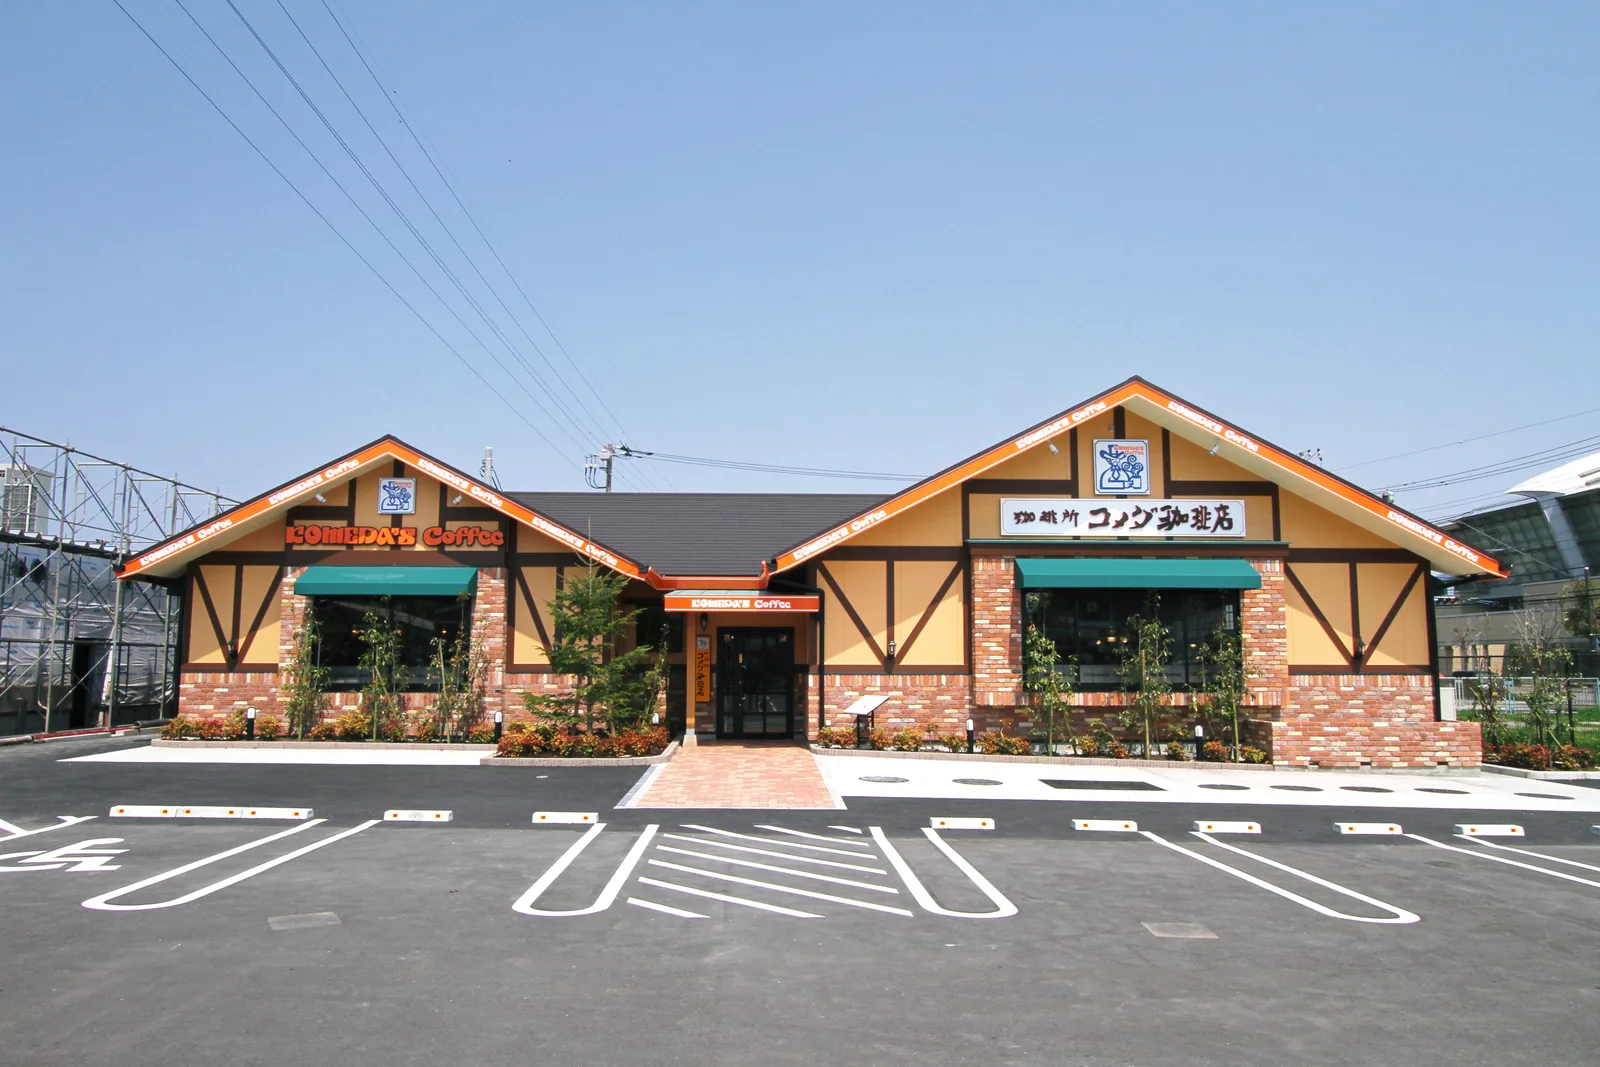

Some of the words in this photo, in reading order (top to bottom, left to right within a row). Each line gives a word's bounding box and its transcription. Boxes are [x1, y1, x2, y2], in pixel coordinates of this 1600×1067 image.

[1015, 417, 1070, 449] KOMEDA'S
[1071, 401, 1107, 422] Coffee
[1167, 401, 1223, 433] KOMEDA'S
[1224, 430, 1259, 453] Coffee
[268, 475, 323, 505] KOMEDA'S
[325, 459, 360, 479] Coffee
[417, 458, 469, 489] KOMEDA'S
[470, 486, 504, 507] Coffee
[285, 525, 417, 546] KOMEDA'S
[423, 526, 504, 547] Coffee
[531, 516, 583, 548] KOMEDA'S
[793, 527, 849, 560] KOMEDA'S
[851, 509, 887, 532] Coffee
[1088, 503, 1234, 533] コメダ珈琲店
[1387, 510, 1443, 543] KOMEDA'S
[1444, 540, 1479, 563] Coffee
[140, 534, 195, 566] KOMEDA'S
[197, 519, 233, 539] Coffee
[691, 599, 751, 608] KOMEDA'S
[754, 599, 791, 608] Coffee
